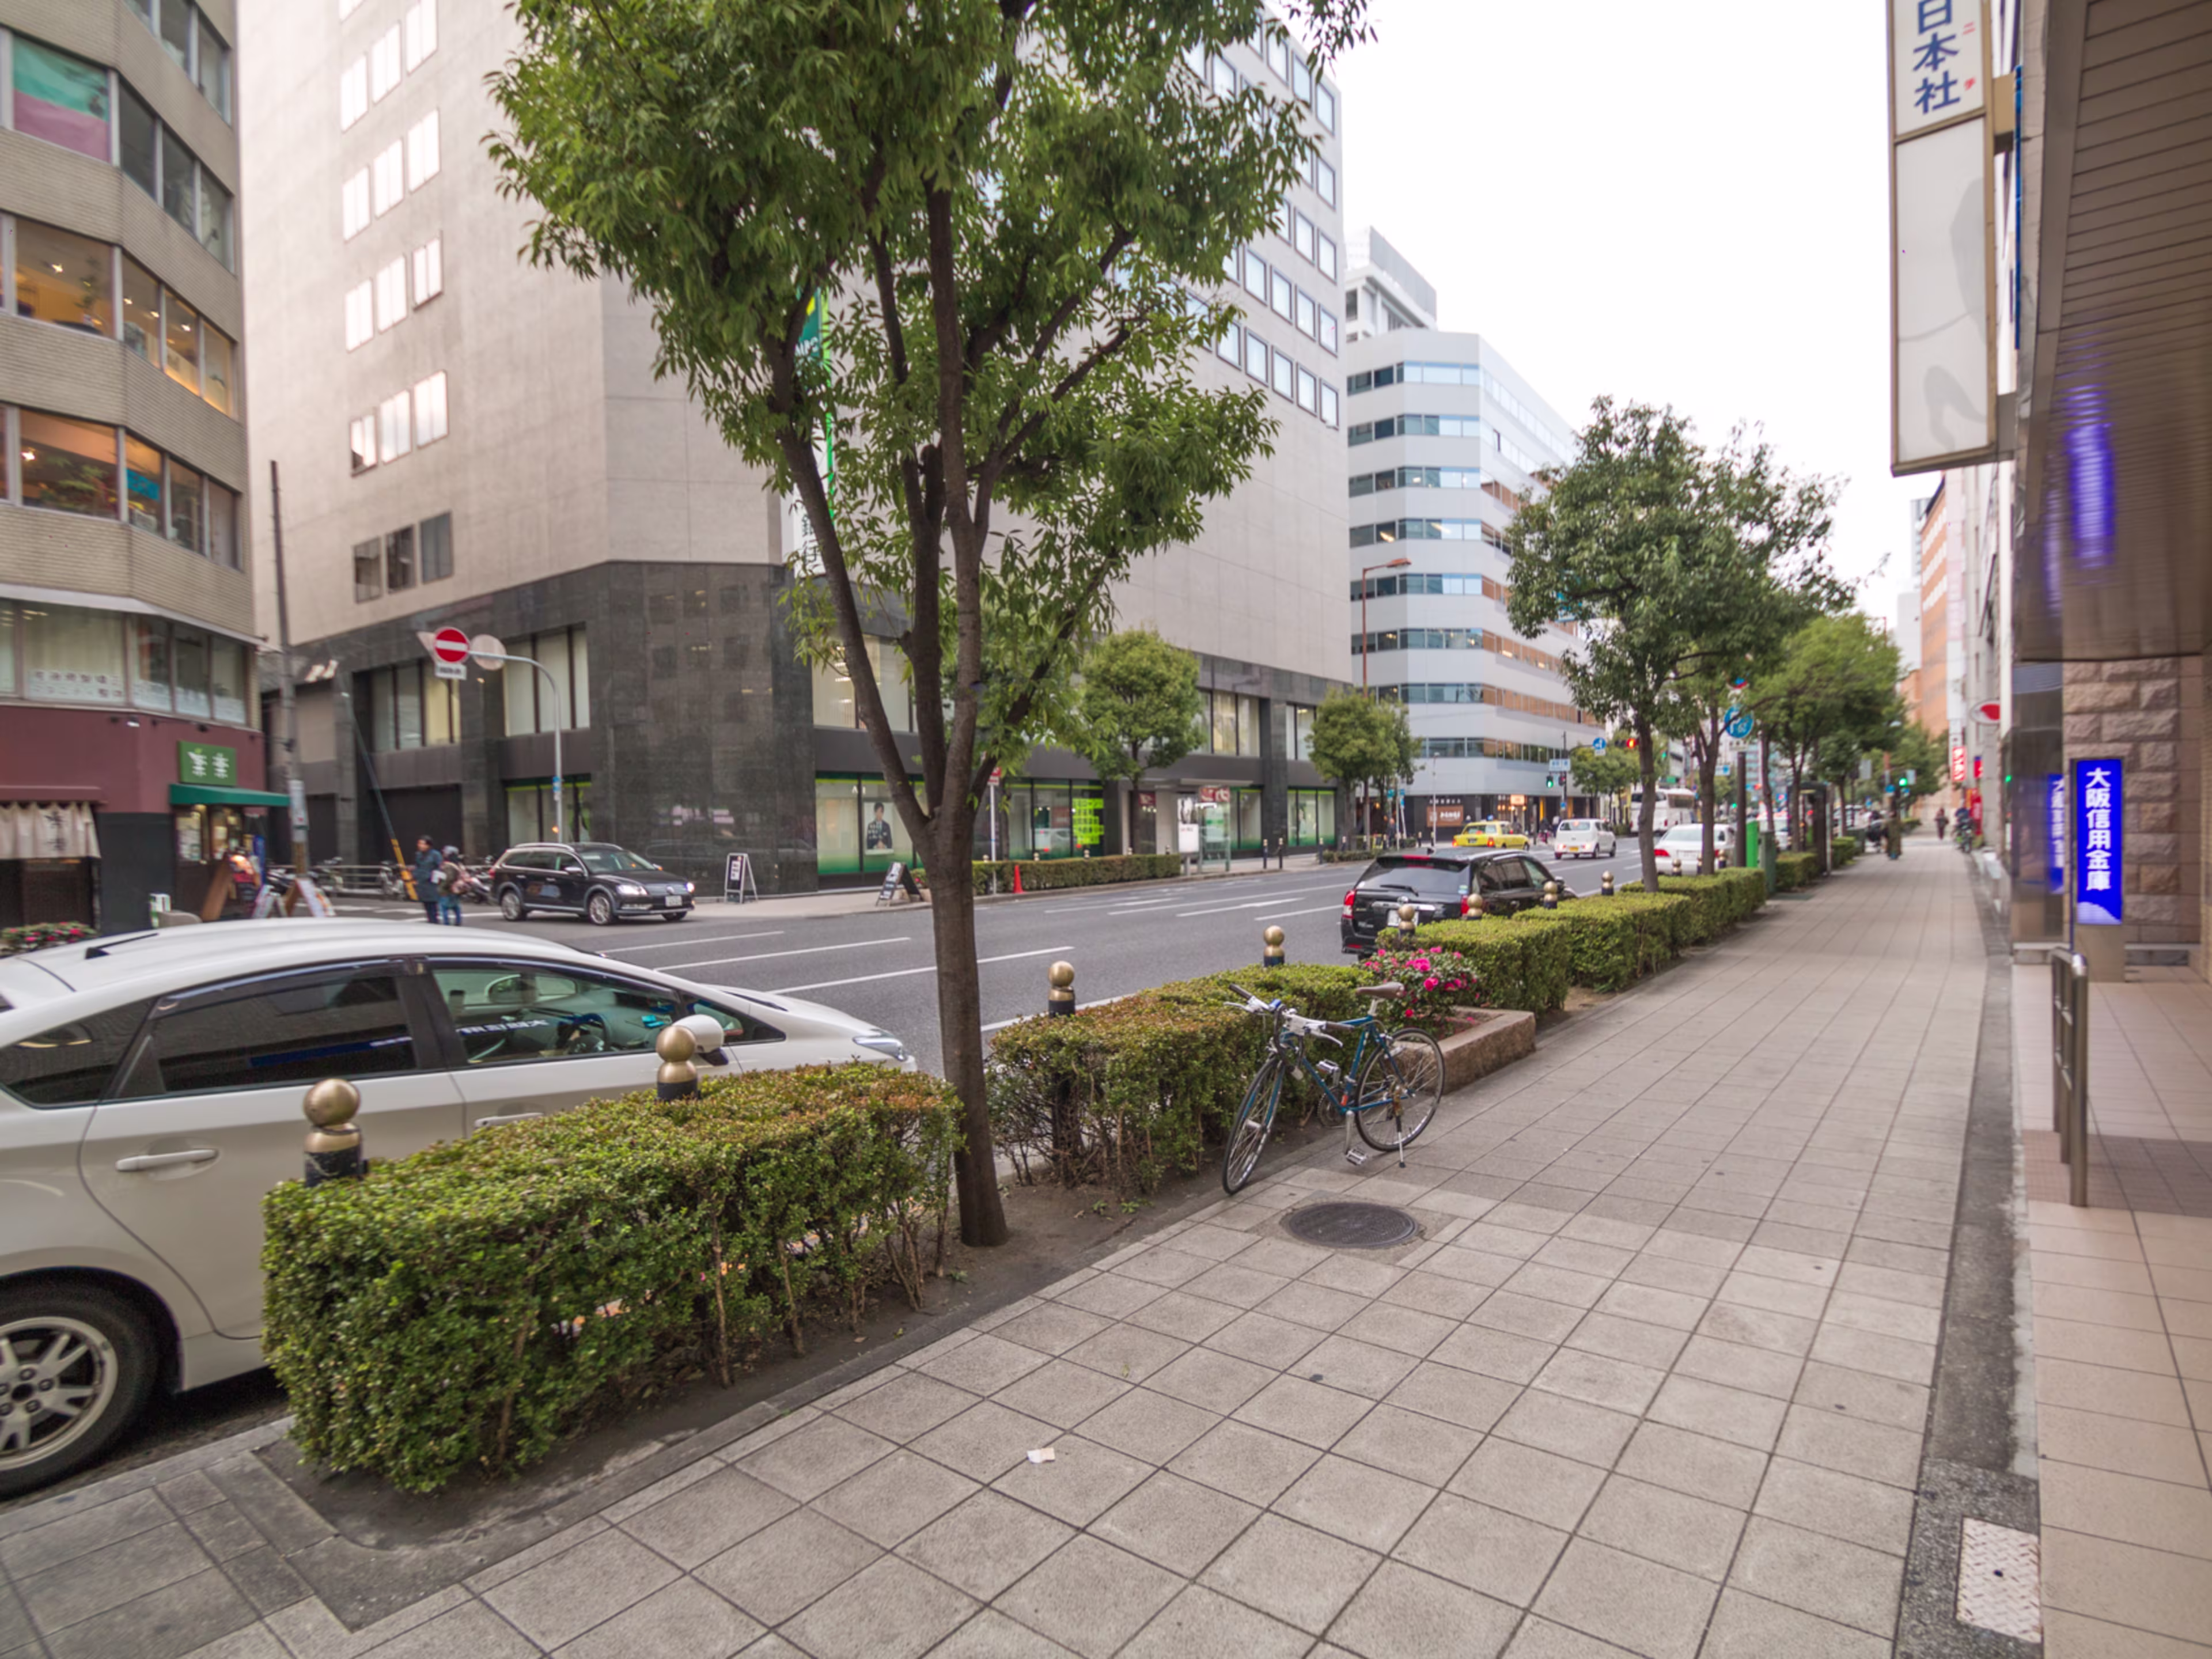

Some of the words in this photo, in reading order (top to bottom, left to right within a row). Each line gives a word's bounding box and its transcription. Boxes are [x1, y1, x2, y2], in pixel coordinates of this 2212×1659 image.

[1913, 0, 1961, 115] 日本社
[2085, 767, 2112, 891] 大阪信用金庫
